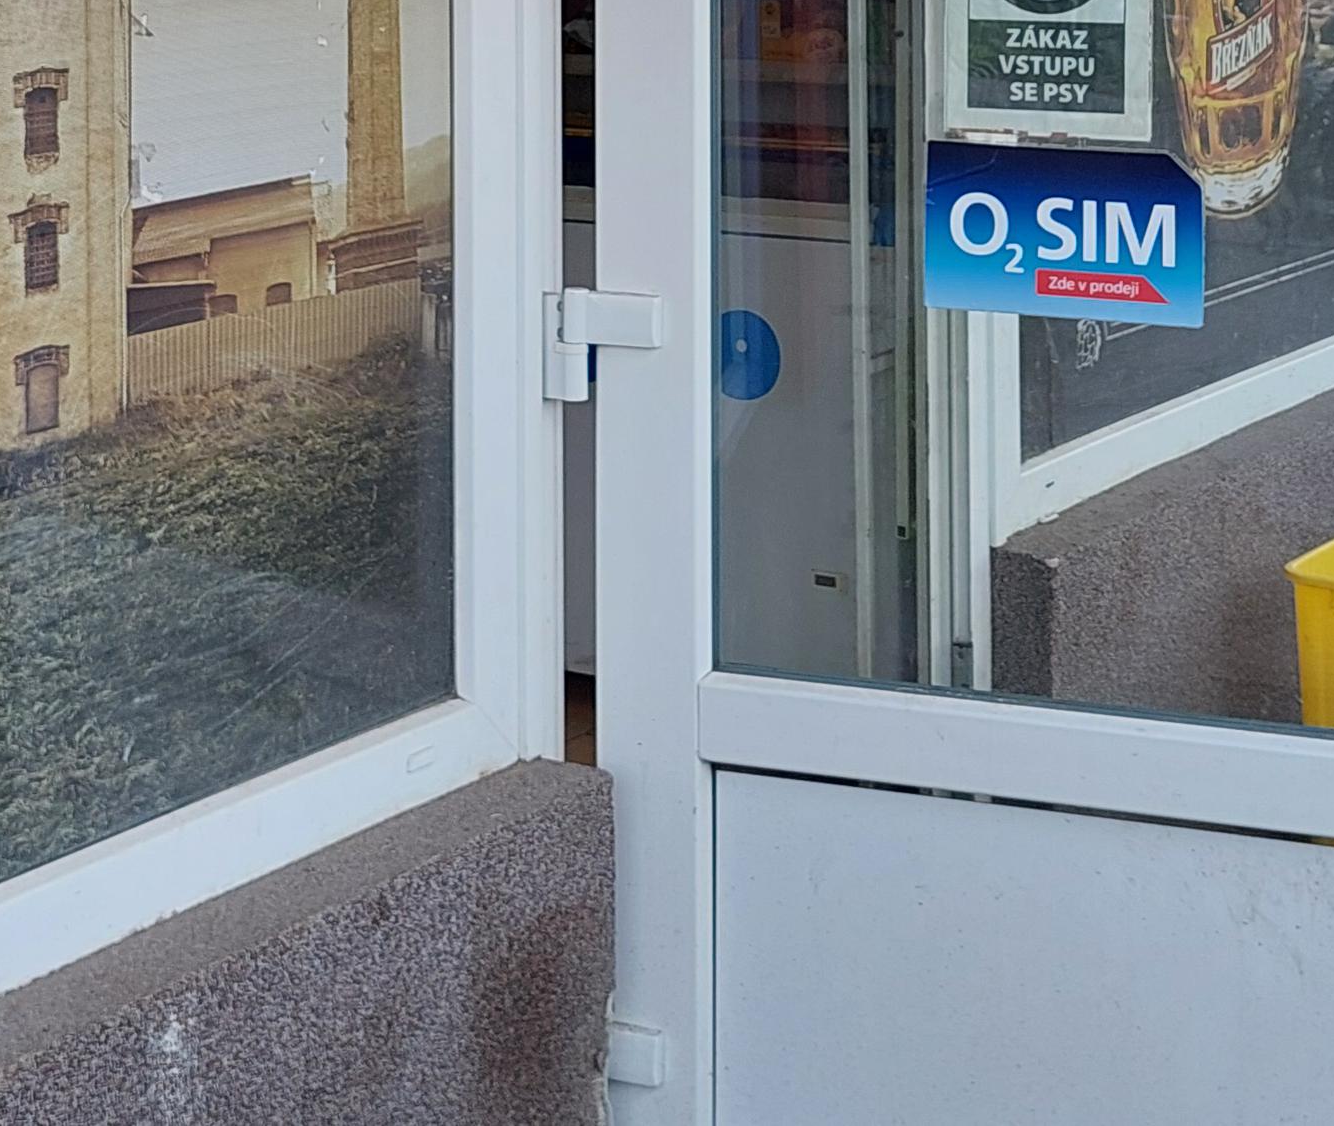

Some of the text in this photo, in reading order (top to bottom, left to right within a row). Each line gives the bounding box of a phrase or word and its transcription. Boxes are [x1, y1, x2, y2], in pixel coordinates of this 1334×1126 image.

[1004, 23, 1090, 50] ZÁKAZ
[997, 53, 1096, 77] VSTUPU
[1008, 81, 1091, 104] SE PSY
[1035, 196, 1177, 268] SIM
[1048, 275, 1141, 299] Zde v prodeji
